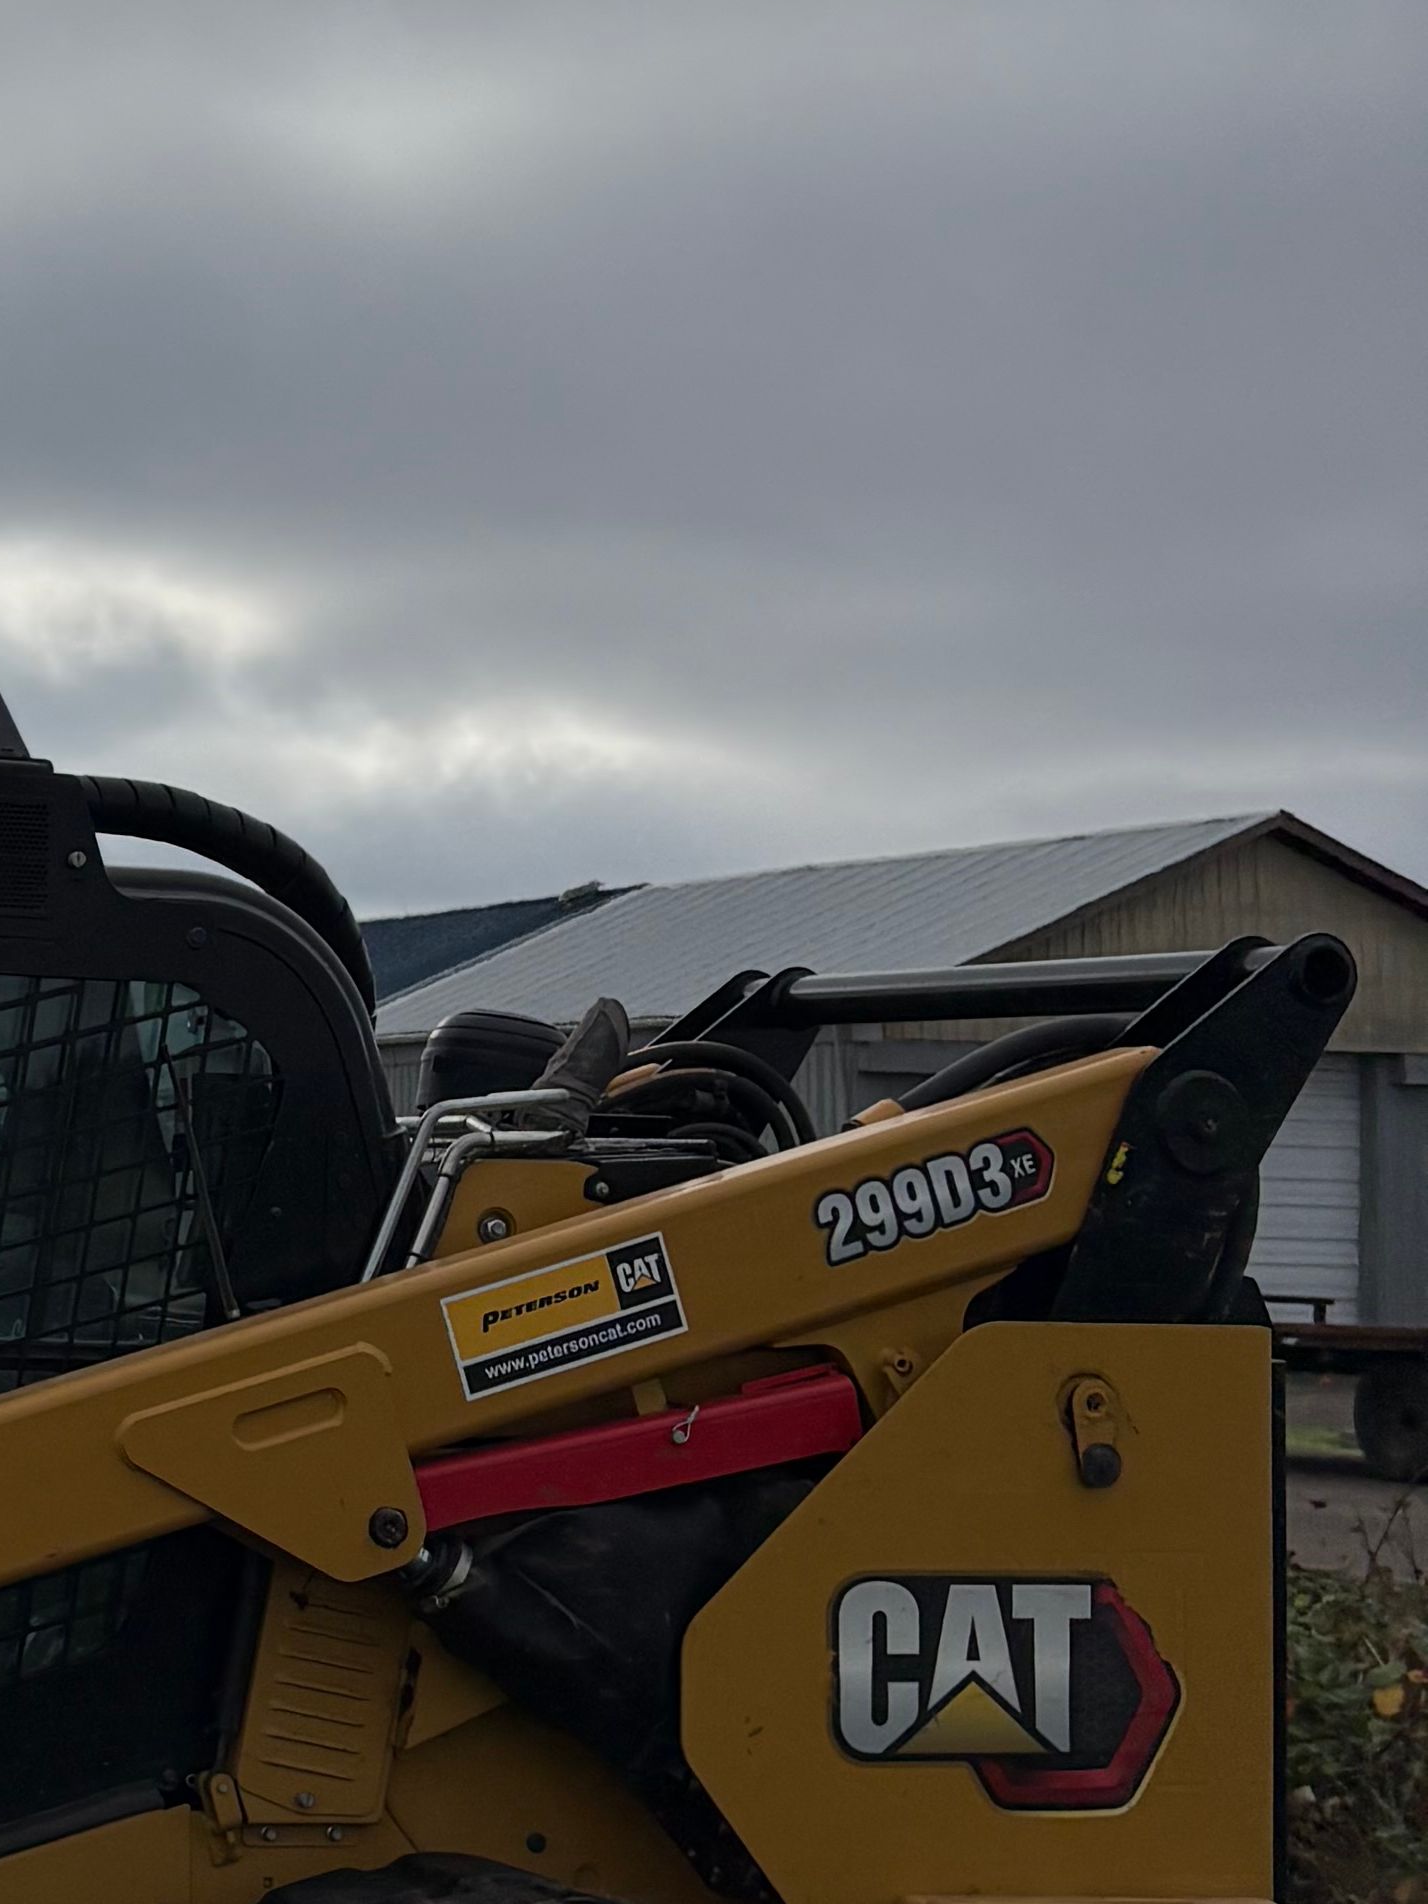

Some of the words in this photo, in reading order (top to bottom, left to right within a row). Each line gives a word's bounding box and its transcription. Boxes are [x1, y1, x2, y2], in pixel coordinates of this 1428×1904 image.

[817, 1142, 1013, 1264] 299D3
[1009, 1153, 1037, 1179] XE
[482, 1280, 600, 1333] PETERSON
[615, 1253, 662, 1294] CAT
[485, 1312, 662, 1380] www.petersoncat.com
[838, 1579, 1093, 1755] CAT
